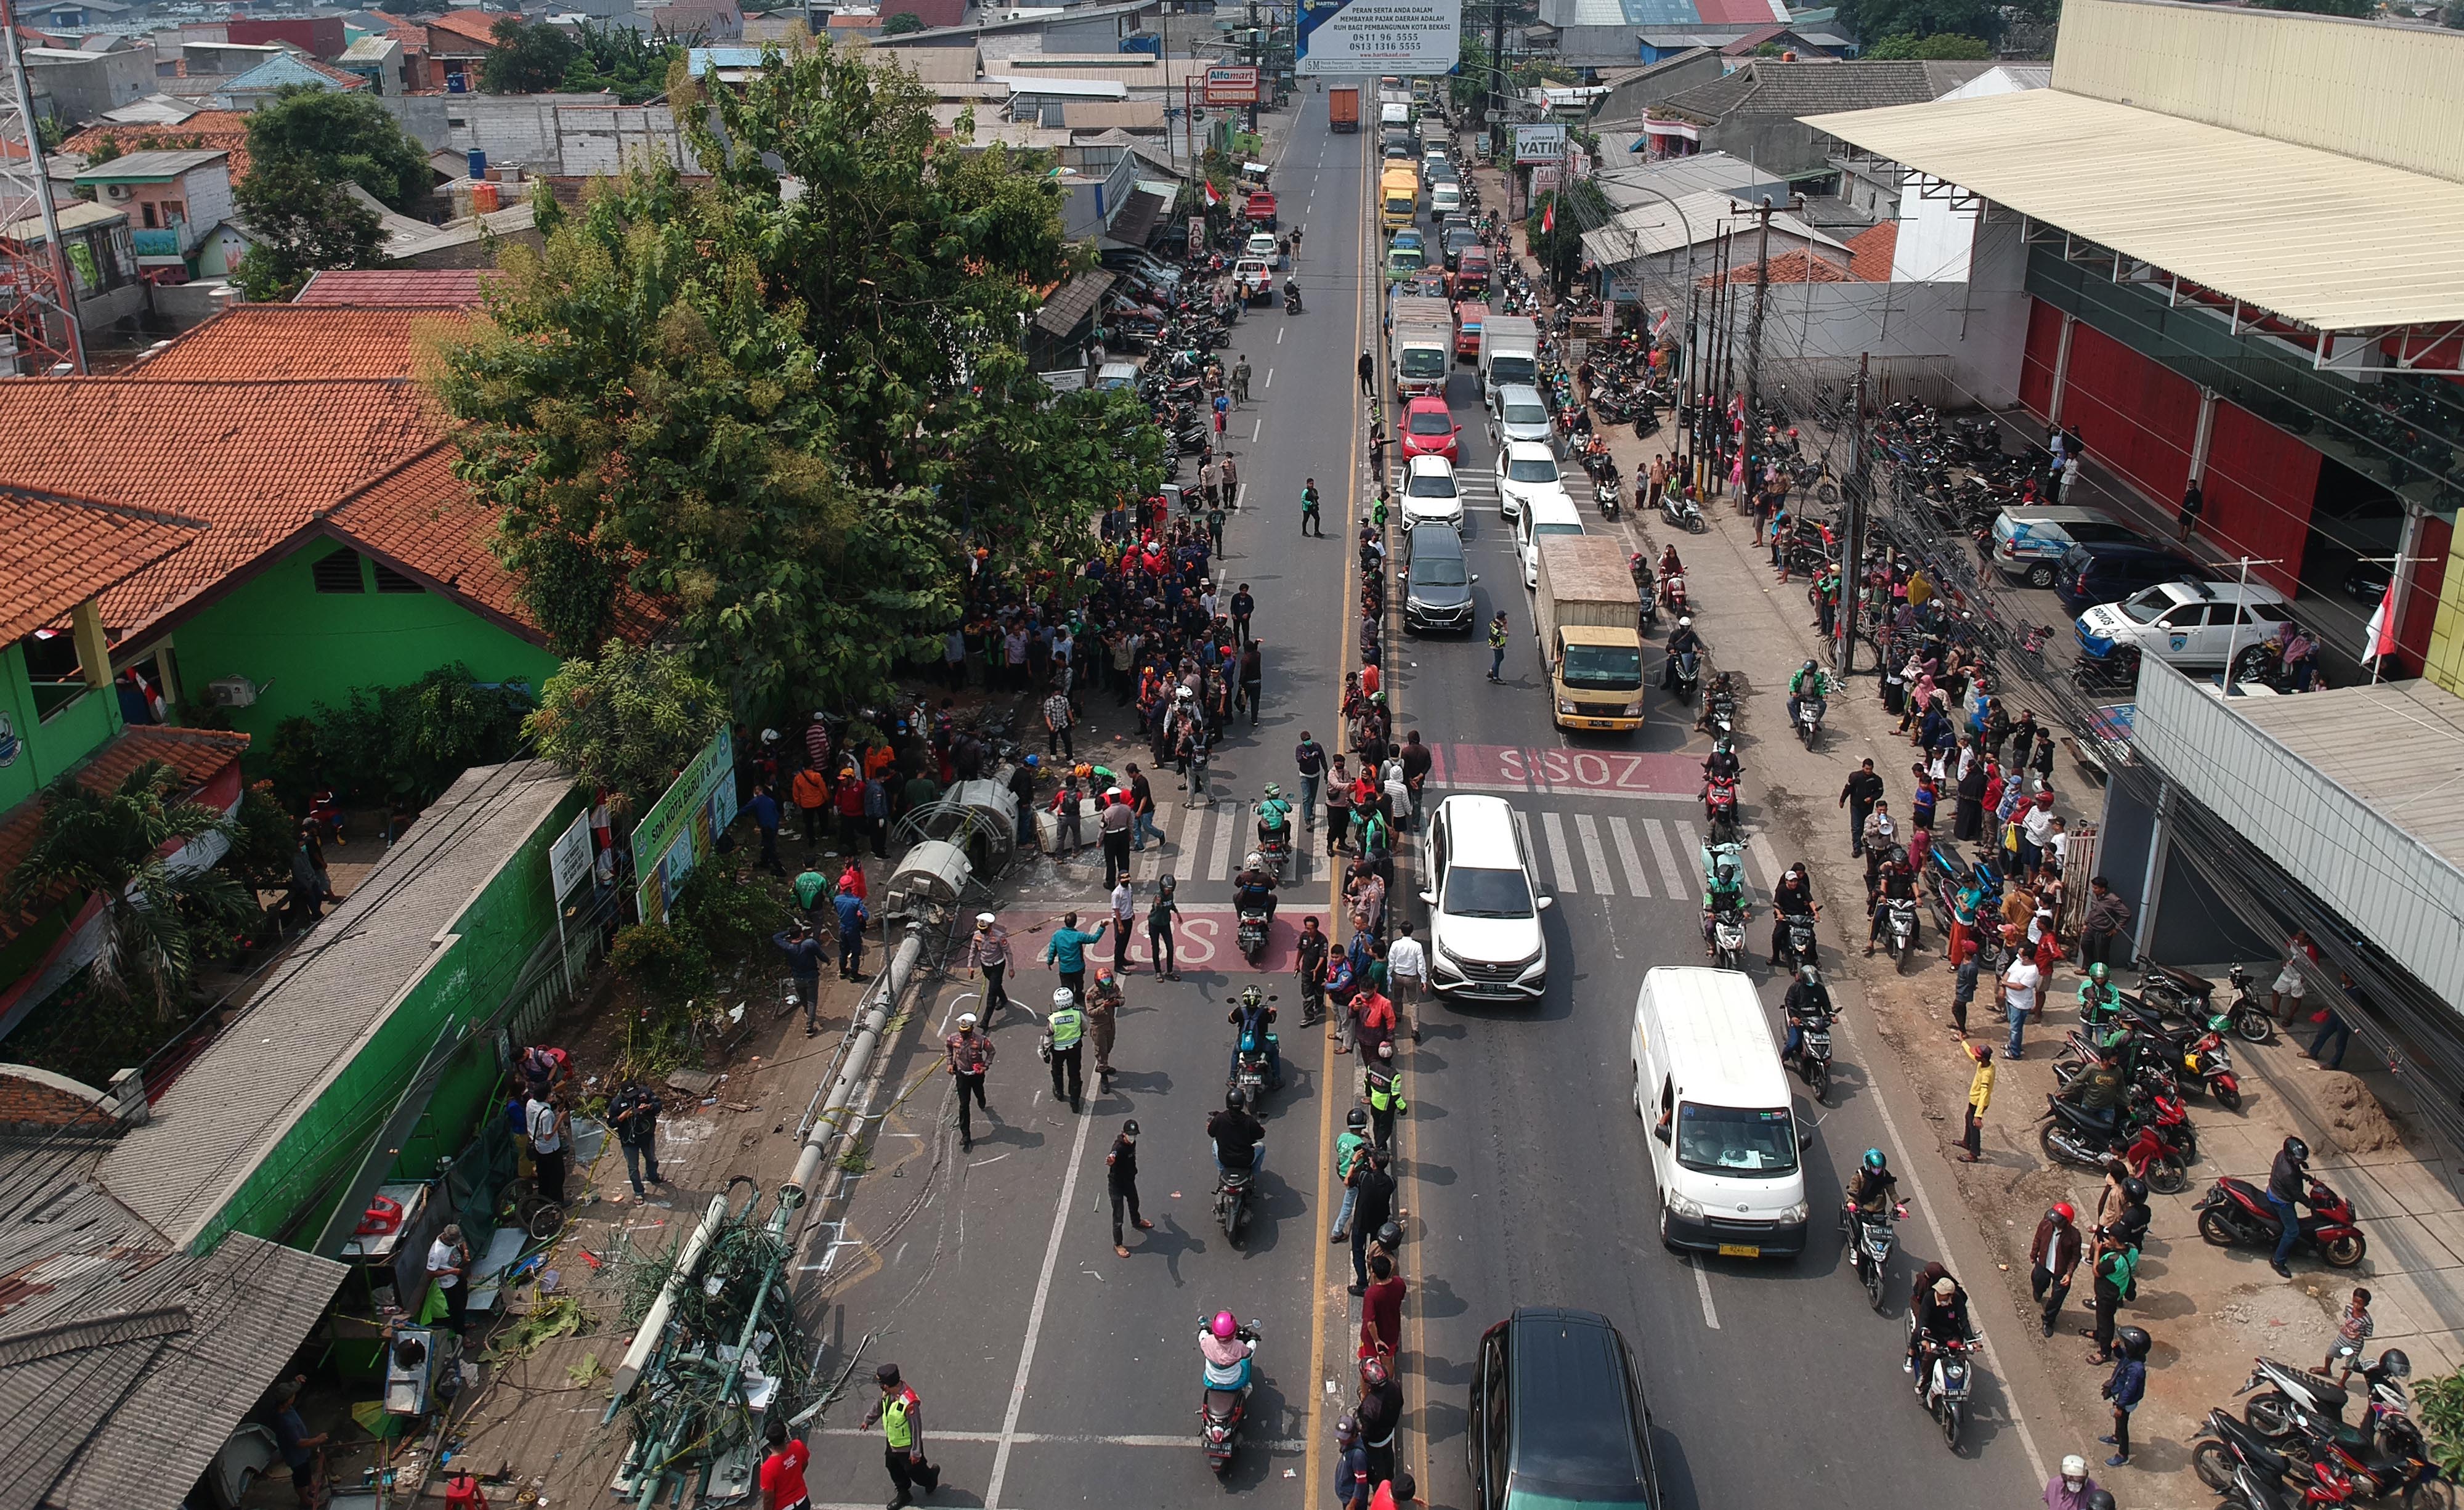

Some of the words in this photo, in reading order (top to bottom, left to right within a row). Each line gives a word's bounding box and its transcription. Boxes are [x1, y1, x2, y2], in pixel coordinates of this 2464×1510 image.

[1349, 43, 1372, 51] 0813
[1307, 61, 1320, 70] 5M
[1210, 71, 1254, 79] Alfamart
[2090, 607, 2115, 625] PROVOS
[662, 791, 678, 814] DINAS
[677, 758, 706, 793] PENDIDIKAN
[651, 821, 665, 845] SDN
[665, 801, 683, 824] KOTA
[683, 781, 700, 805] BARU
[706, 765, 711, 777] &
